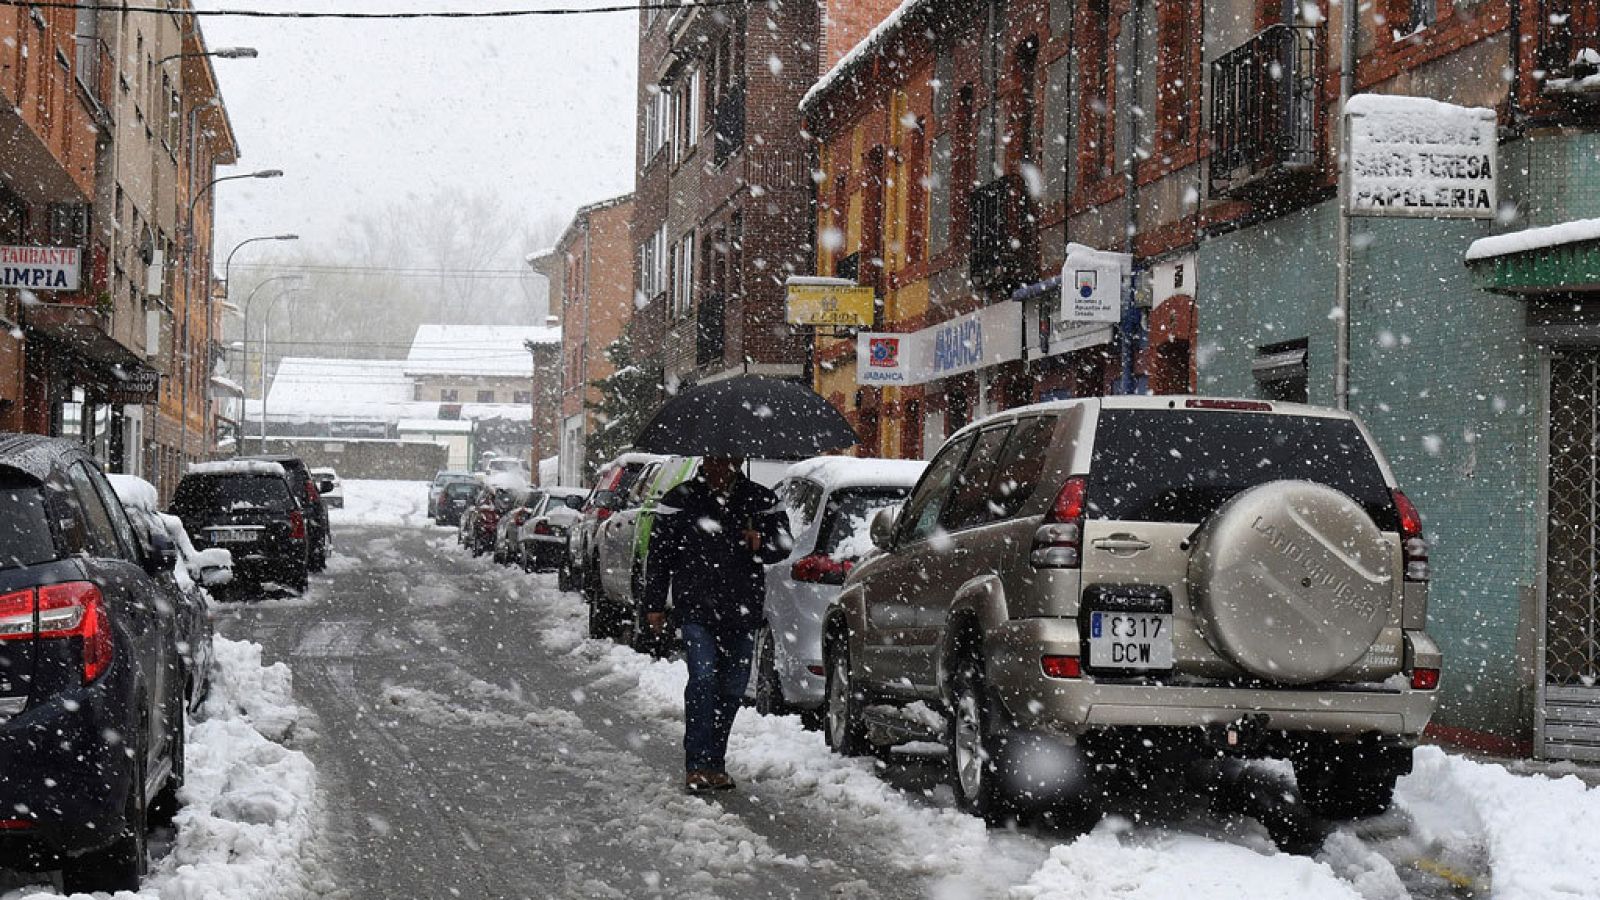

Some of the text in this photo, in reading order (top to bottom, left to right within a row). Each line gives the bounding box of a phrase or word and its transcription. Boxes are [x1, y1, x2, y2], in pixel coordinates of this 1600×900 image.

[1418, 152, 1493, 179] TERESA
[1111, 616, 1163, 639] 8317
[1112, 642, 1151, 664] DCW
